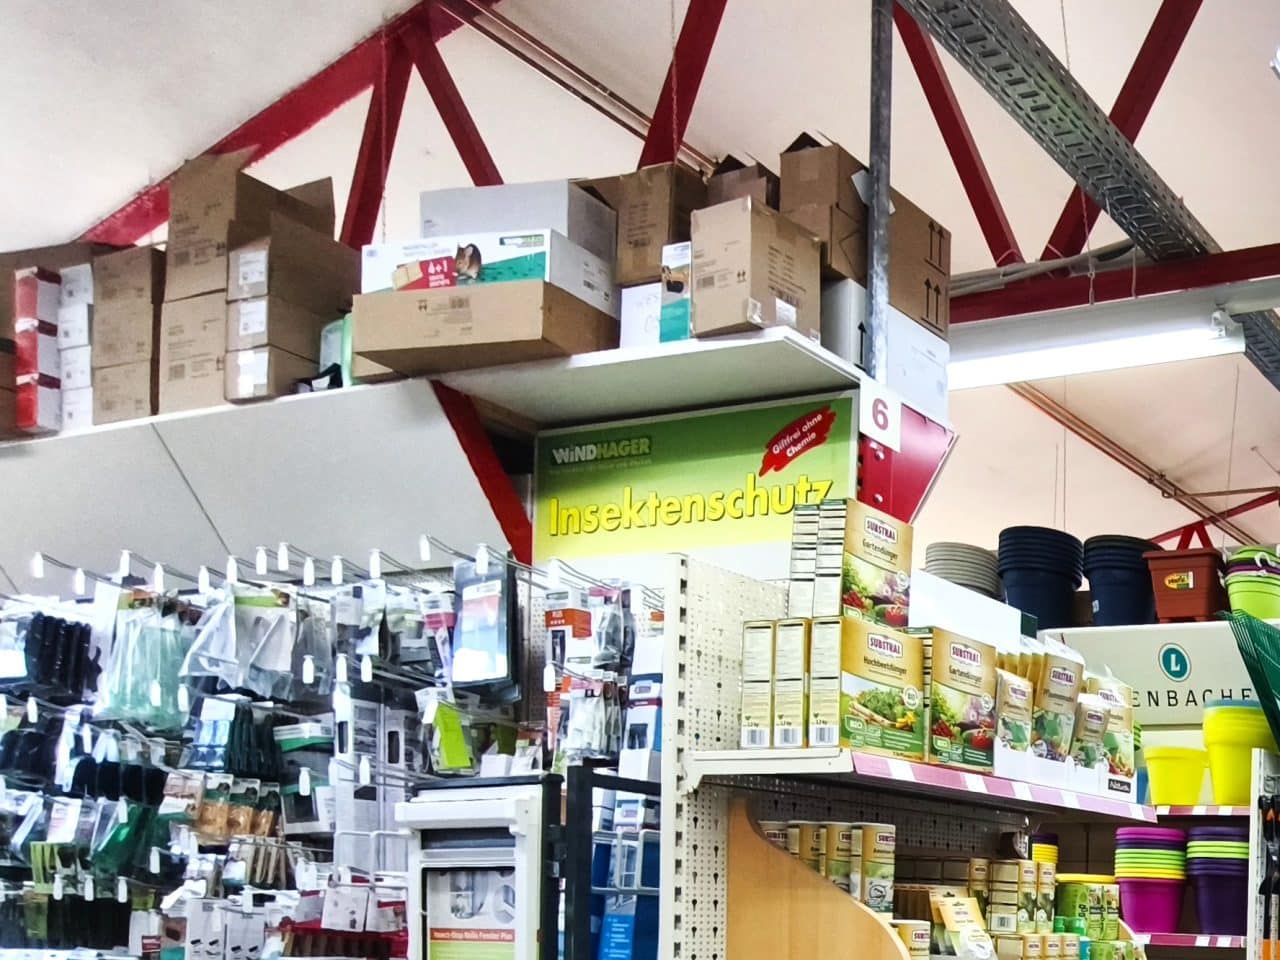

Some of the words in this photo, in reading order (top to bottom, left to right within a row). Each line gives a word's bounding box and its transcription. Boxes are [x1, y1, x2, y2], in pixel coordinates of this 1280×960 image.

[871, 397, 889, 431] 6
[772, 426, 801, 454] Giftfrei
[802, 413, 822, 432] ohne
[786, 432, 816, 457] Chemie
[548, 472, 834, 537] Insektenschutz
[866, 519, 896, 541] SUBSTRAL
[870, 637, 901, 655] SUBSTRAL
[952, 645, 980, 663] SUBSTRAL
